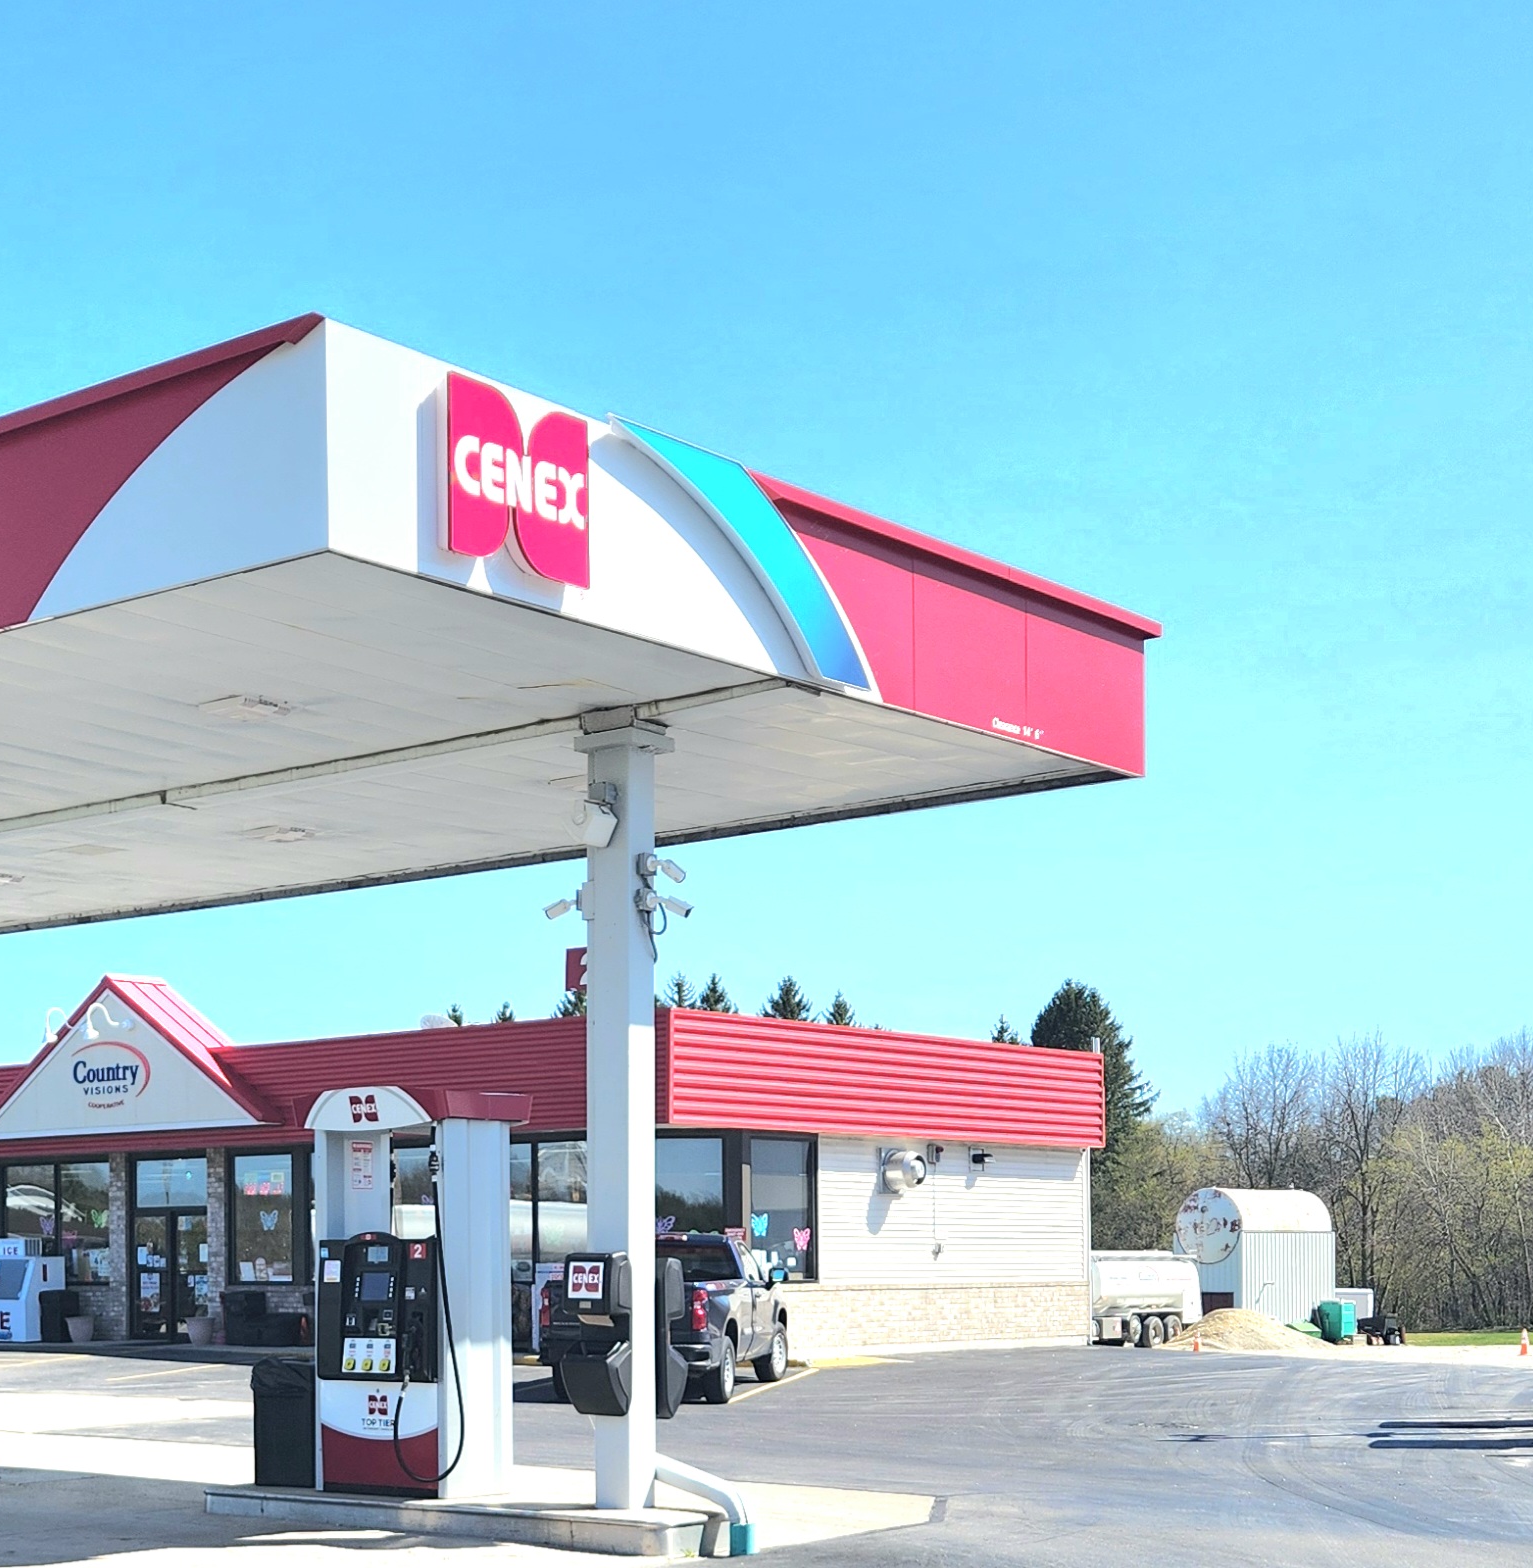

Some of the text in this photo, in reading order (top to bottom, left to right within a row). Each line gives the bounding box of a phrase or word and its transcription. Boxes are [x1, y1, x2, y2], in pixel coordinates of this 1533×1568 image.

[453, 434, 586, 531] CENEX
[73, 1060, 139, 1085] Country
[83, 1084, 129, 1096] VISIONS
[88, 1099, 125, 1110] COOPERATIVE
[351, 1103, 377, 1115] CENEX
[3, 1246, 18, 1256] ICE
[413, 1243, 422, 1259] 2
[573, 1272, 600, 1284] CENEX
[361, 1417, 376, 1427] TOP
